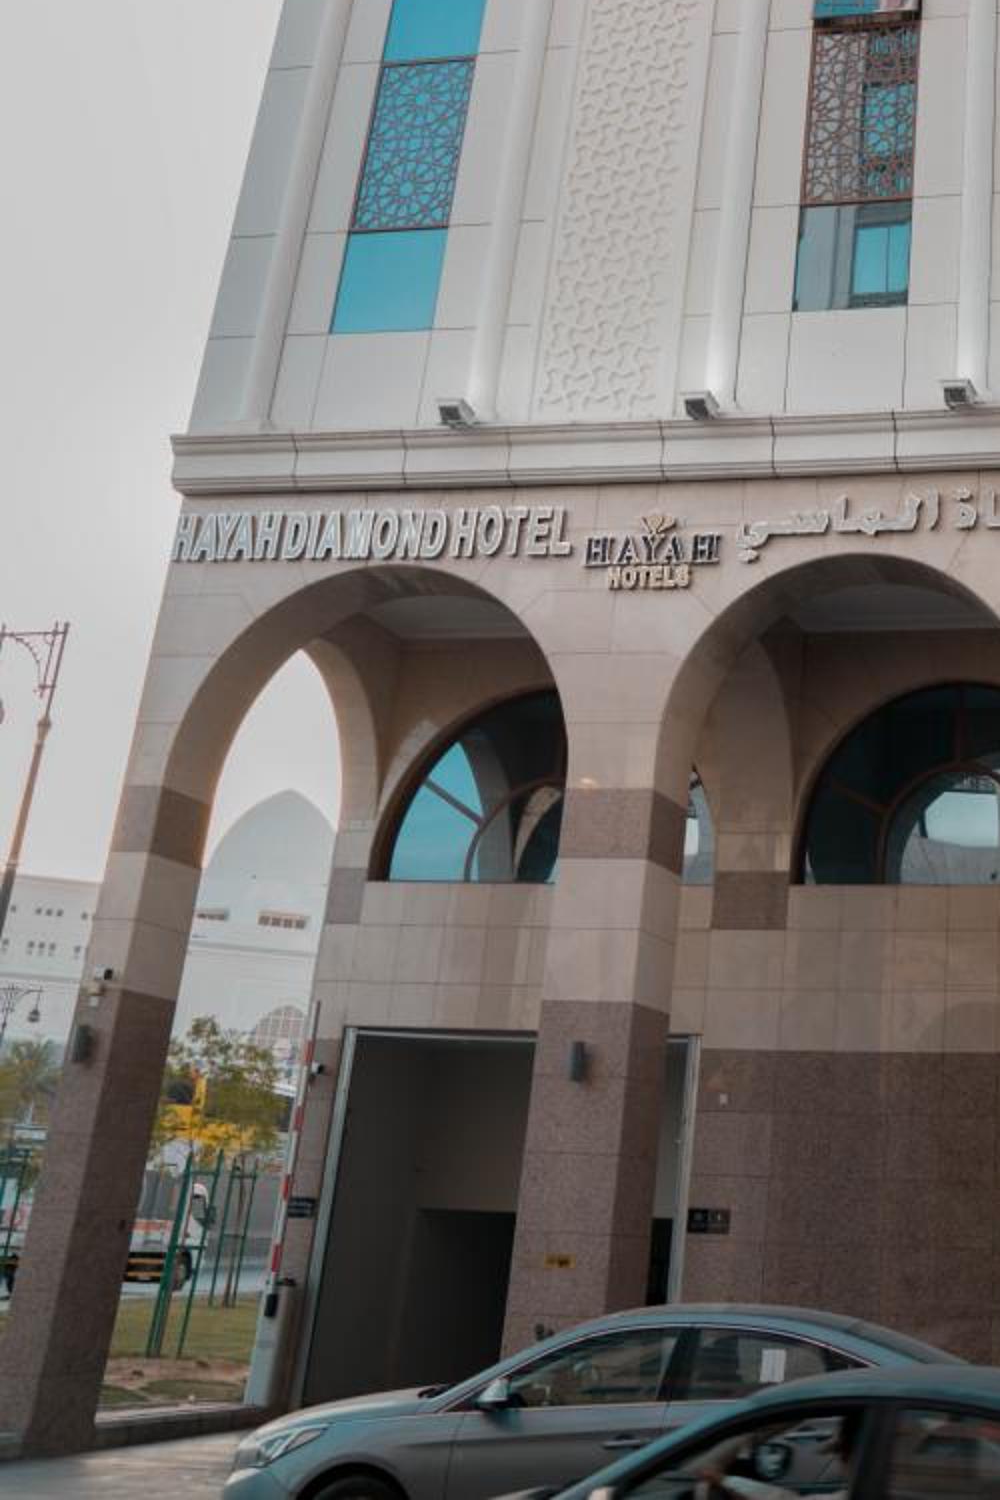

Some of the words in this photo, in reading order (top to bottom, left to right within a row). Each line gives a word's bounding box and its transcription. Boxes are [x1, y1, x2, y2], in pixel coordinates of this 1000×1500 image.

[173, 512, 283, 563] HAYAH
[282, 508, 449, 561] DIAMOND
[451, 505, 573, 559] HOTEL
[736, 486, 941, 564] الماسي
[584, 532, 722, 568] HAYAH
[607, 564, 692, 591] HOTELS
